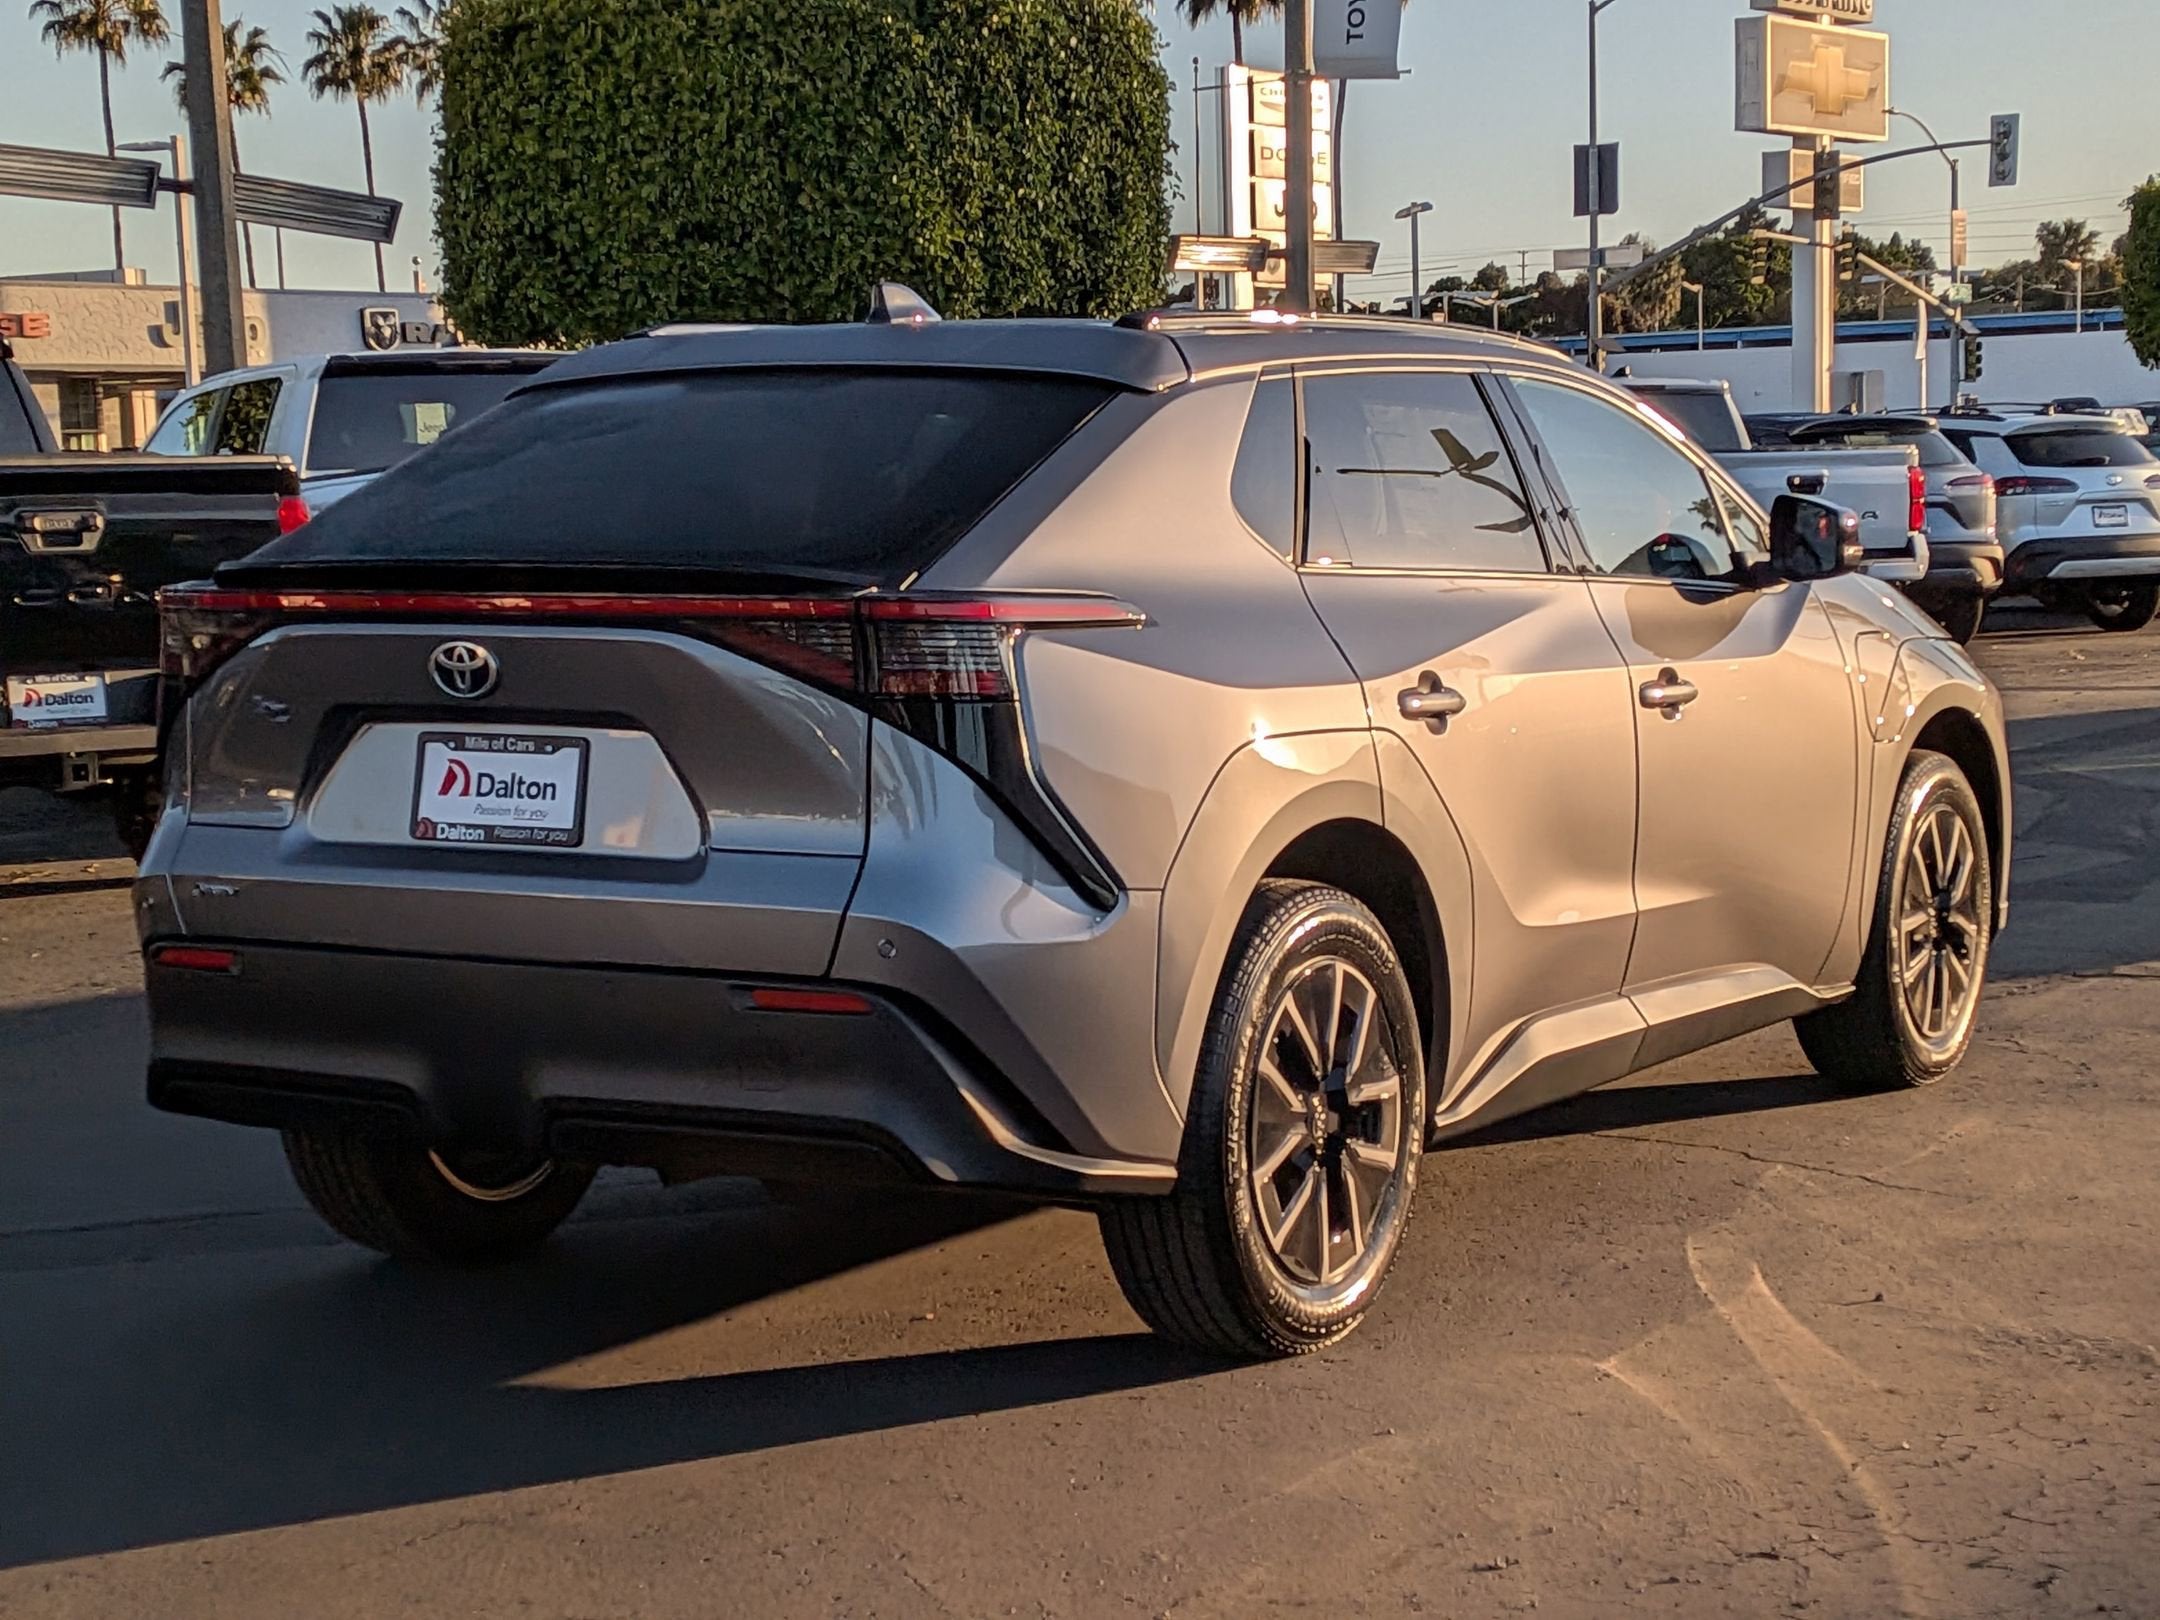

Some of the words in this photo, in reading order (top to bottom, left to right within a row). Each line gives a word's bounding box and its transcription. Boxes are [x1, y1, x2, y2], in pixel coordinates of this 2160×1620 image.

[45, 692, 94, 706] Dalton
[475, 772, 557, 801] Dalton
[436, 823, 485, 840] Dalton
